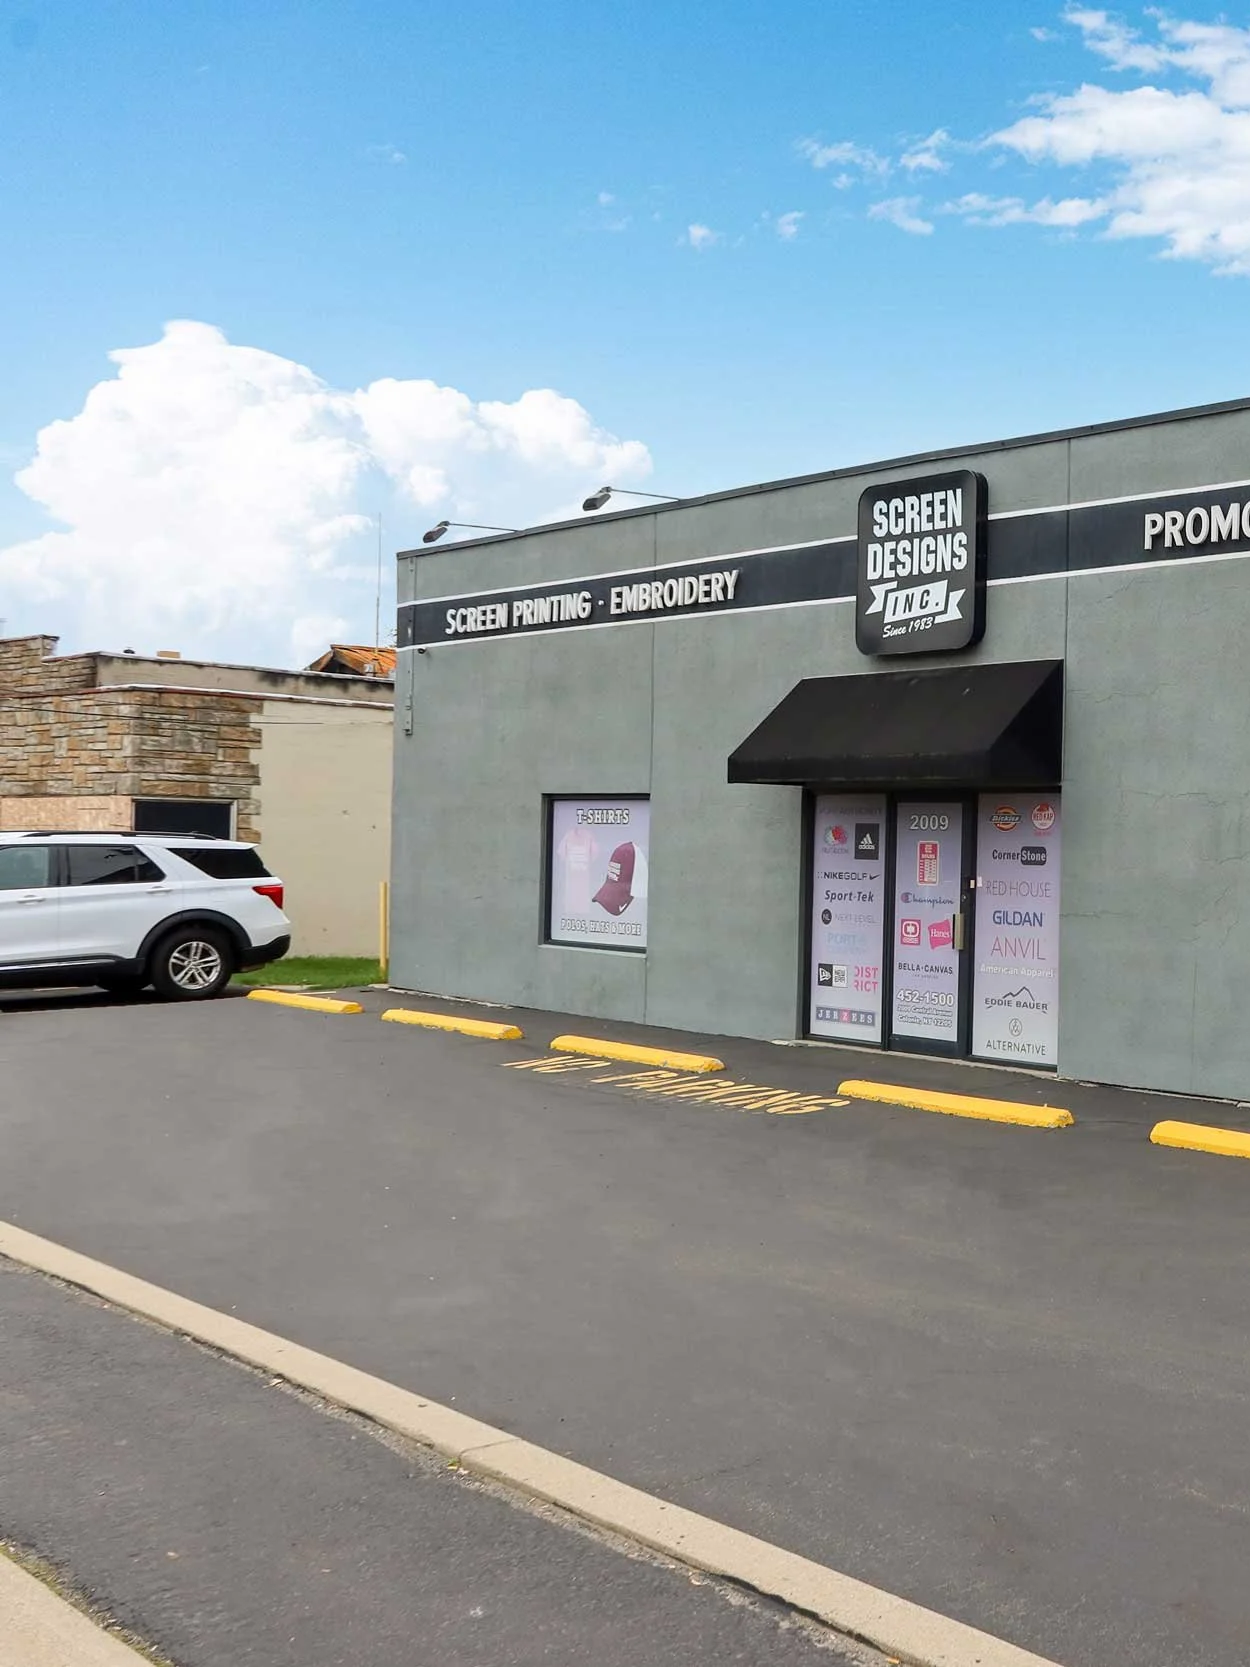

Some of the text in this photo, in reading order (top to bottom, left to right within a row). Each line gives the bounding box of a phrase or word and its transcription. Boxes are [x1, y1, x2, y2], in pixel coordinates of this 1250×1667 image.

[872, 488, 962, 538] SCREEN
[867, 532, 968, 581] DESIGNS
[445, 602, 508, 635] SCREEN
[513, 591, 593, 627] PRINTING
[610, 570, 740, 615] EMBROIDERY
[892, 589, 940, 617] INC.
[882, 616, 934, 639] Since 1983
[576, 808, 630, 825] T-SHIRTS
[910, 815, 949, 830] 2009
[824, 889, 874, 902] Sport-Tek
[985, 880, 1051, 898] RED HOUSE
[992, 910, 1043, 927] GILDAN
[590, 920, 610, 934] HATS
[617, 922, 642, 936] MORE
[991, 935, 1046, 961] ANVIL
[897, 989, 954, 1007] 452-1500
[984, 998, 1048, 1011] EDDIE BAUER
[818, 1009, 873, 1024] JERZEES
[985, 1039, 1046, 1056] ALTERNATIVE
[501, 1055, 851, 1115] NO PARKING
